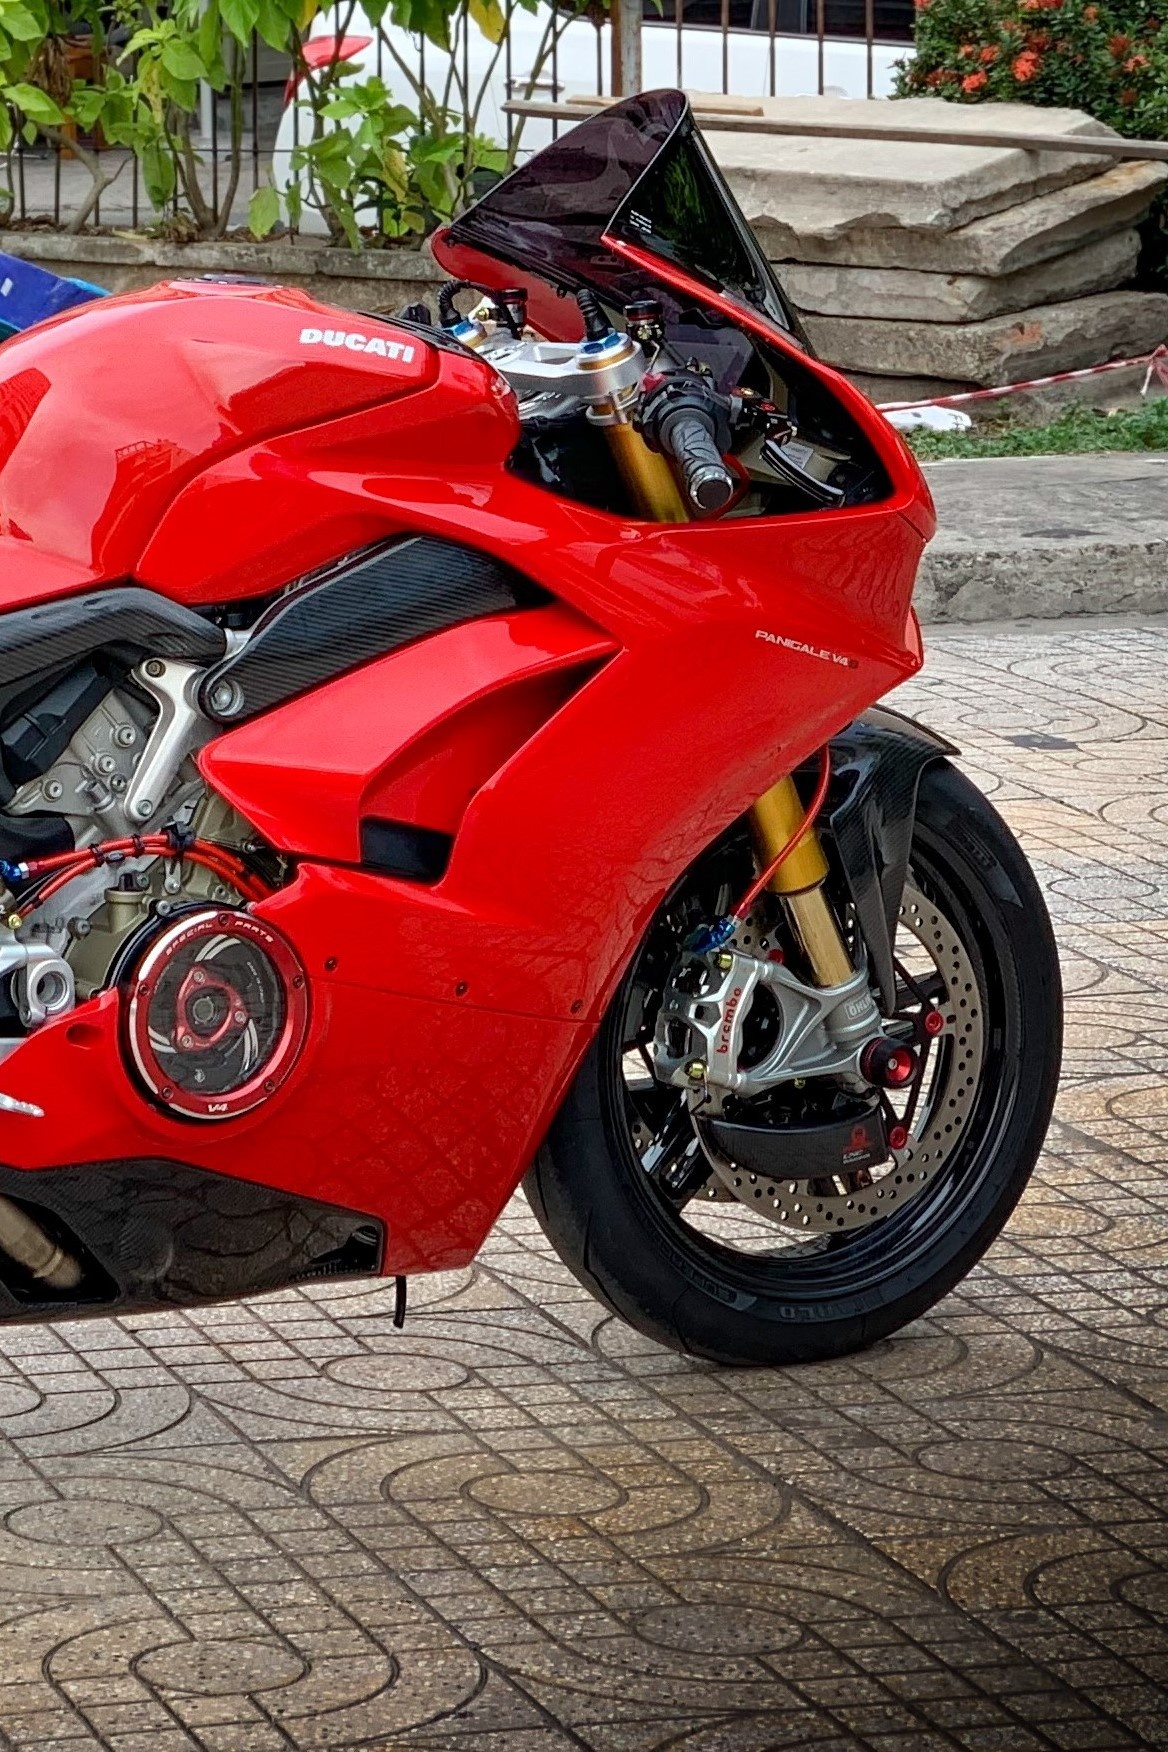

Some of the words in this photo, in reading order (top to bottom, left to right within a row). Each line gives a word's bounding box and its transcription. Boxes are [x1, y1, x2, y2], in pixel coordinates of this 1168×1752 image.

[299, 328, 415, 364] DUCATI
[755, 629, 830, 661] PANIGALE
[166, 923, 213, 956] SPECIAL
[235, 920, 274, 943] PARTS
[716, 987, 742, 1054] brembo
[207, 1102, 229, 1113] V4
